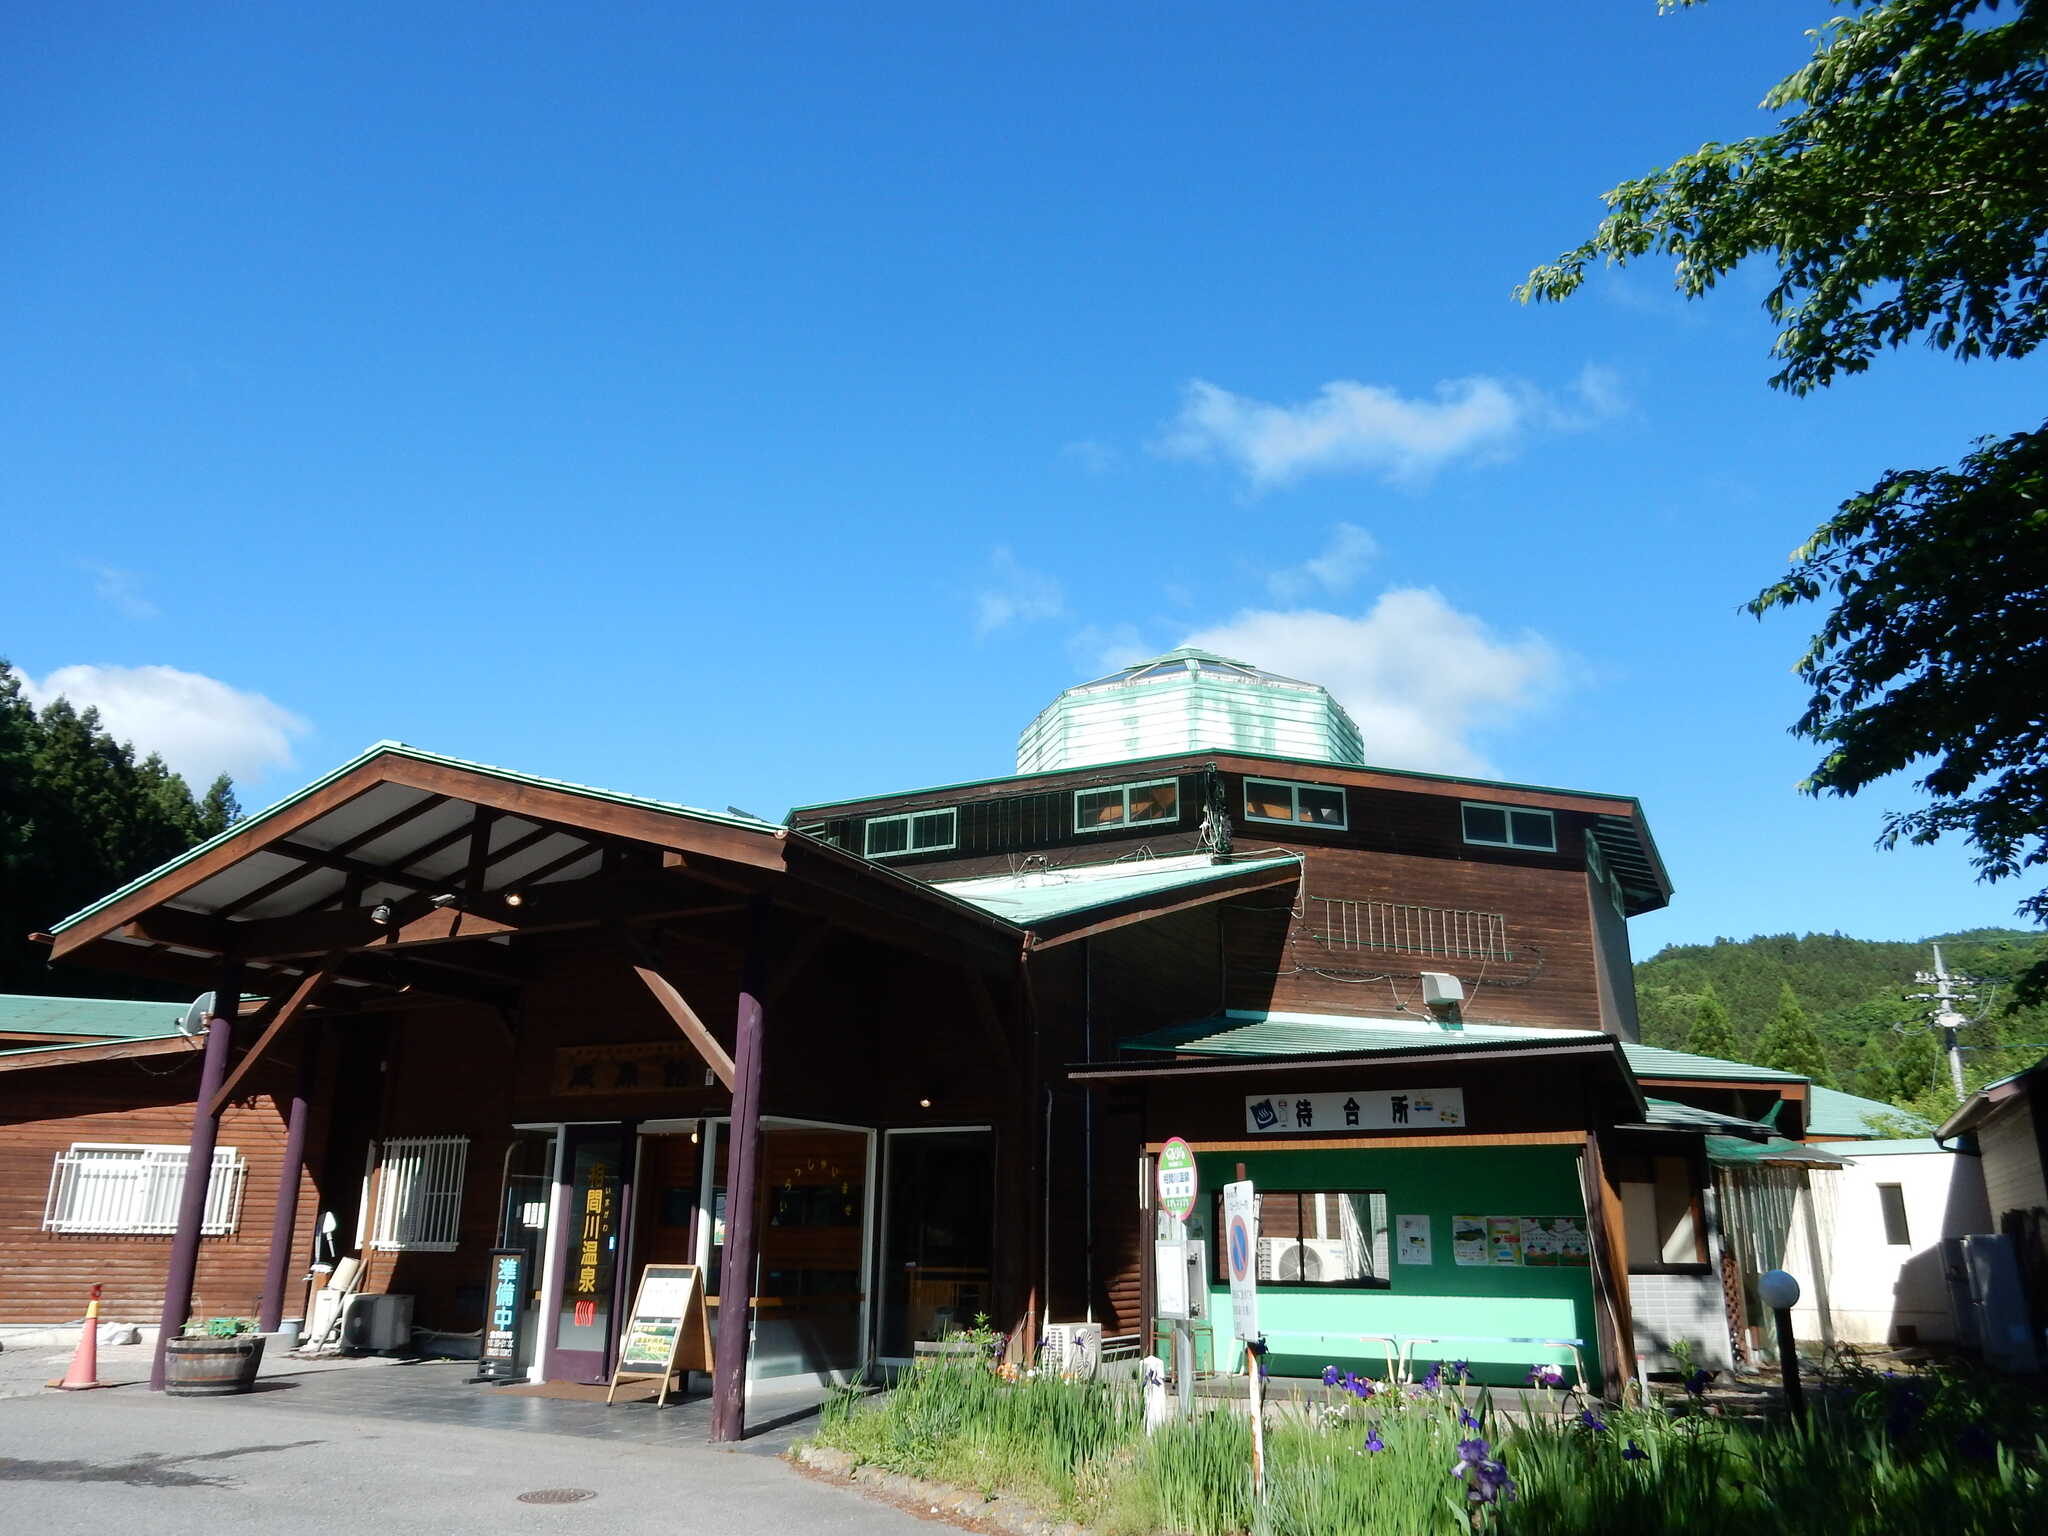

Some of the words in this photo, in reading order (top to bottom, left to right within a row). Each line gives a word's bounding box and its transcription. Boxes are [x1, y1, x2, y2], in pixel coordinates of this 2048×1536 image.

[1295, 1094, 1409, 1128] 待合所
[494, 1258, 518, 1331] 準備中
